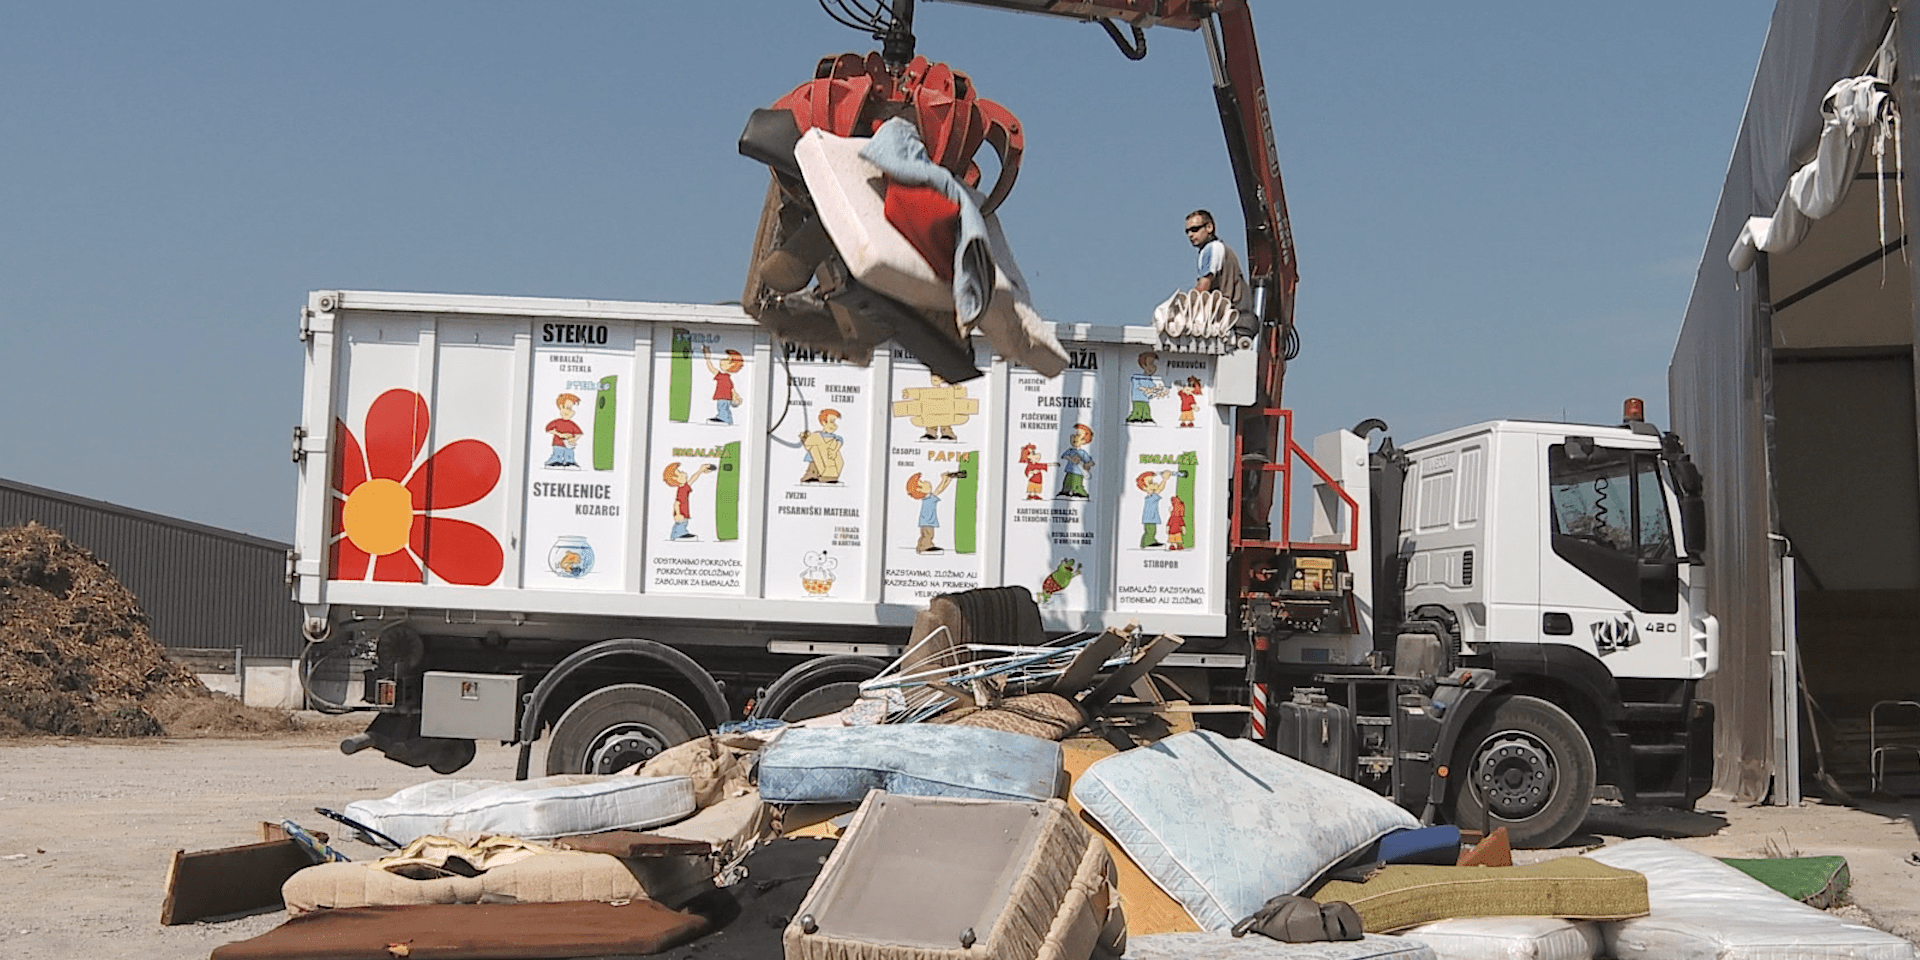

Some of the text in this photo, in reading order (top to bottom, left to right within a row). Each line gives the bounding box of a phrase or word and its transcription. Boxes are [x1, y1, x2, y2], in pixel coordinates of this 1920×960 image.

[543, 324, 608, 345] STEKLO
[550, 355, 583, 363] EMBALAŽA
[567, 365, 591, 373] STEKLA
[1166, 359, 1206, 370] POKROVČKI
[824, 384, 861, 393] REKLAMNI
[831, 394, 854, 403] LETAKI
[1037, 396, 1092, 408] PLASTENKE
[1021, 412, 1057, 421] PLOČEVINKE
[1020, 421, 1058, 430] IN KONZERVE
[672, 446, 731, 458] EMBALAŽA
[892, 446, 921, 455] ČASOPISI
[928, 450, 970, 463] PAPIR
[1139, 452, 1198, 465] EMBALAŽA
[533, 482, 611, 499] STEKLENICE
[785, 491, 807, 500] ZVEZKI
[575, 504, 620, 516] KOZARCI
[778, 504, 859, 517] PISARNIŠKI MATERIAL
[653, 557, 699, 566] ODSTRANIMO
[1143, 559, 1178, 569] STIROPOR
[656, 567, 697, 576] POKROVČEK
[698, 569, 734, 577] ODLOŽIMO
[934, 570, 964, 578] ZLOŽIMO
[966, 571, 978, 579] ALI
[654, 577, 688, 586] ZABOJNIK
[690, 578, 700, 586] ZA
[883, 578, 927, 587] RAZREŽEMO
[1118, 584, 1157, 593] EMBALAŽO
[1119, 596, 1156, 604] STISNEMO
[1158, 596, 1169, 604] ALI
[1645, 622, 1677, 633] 420
